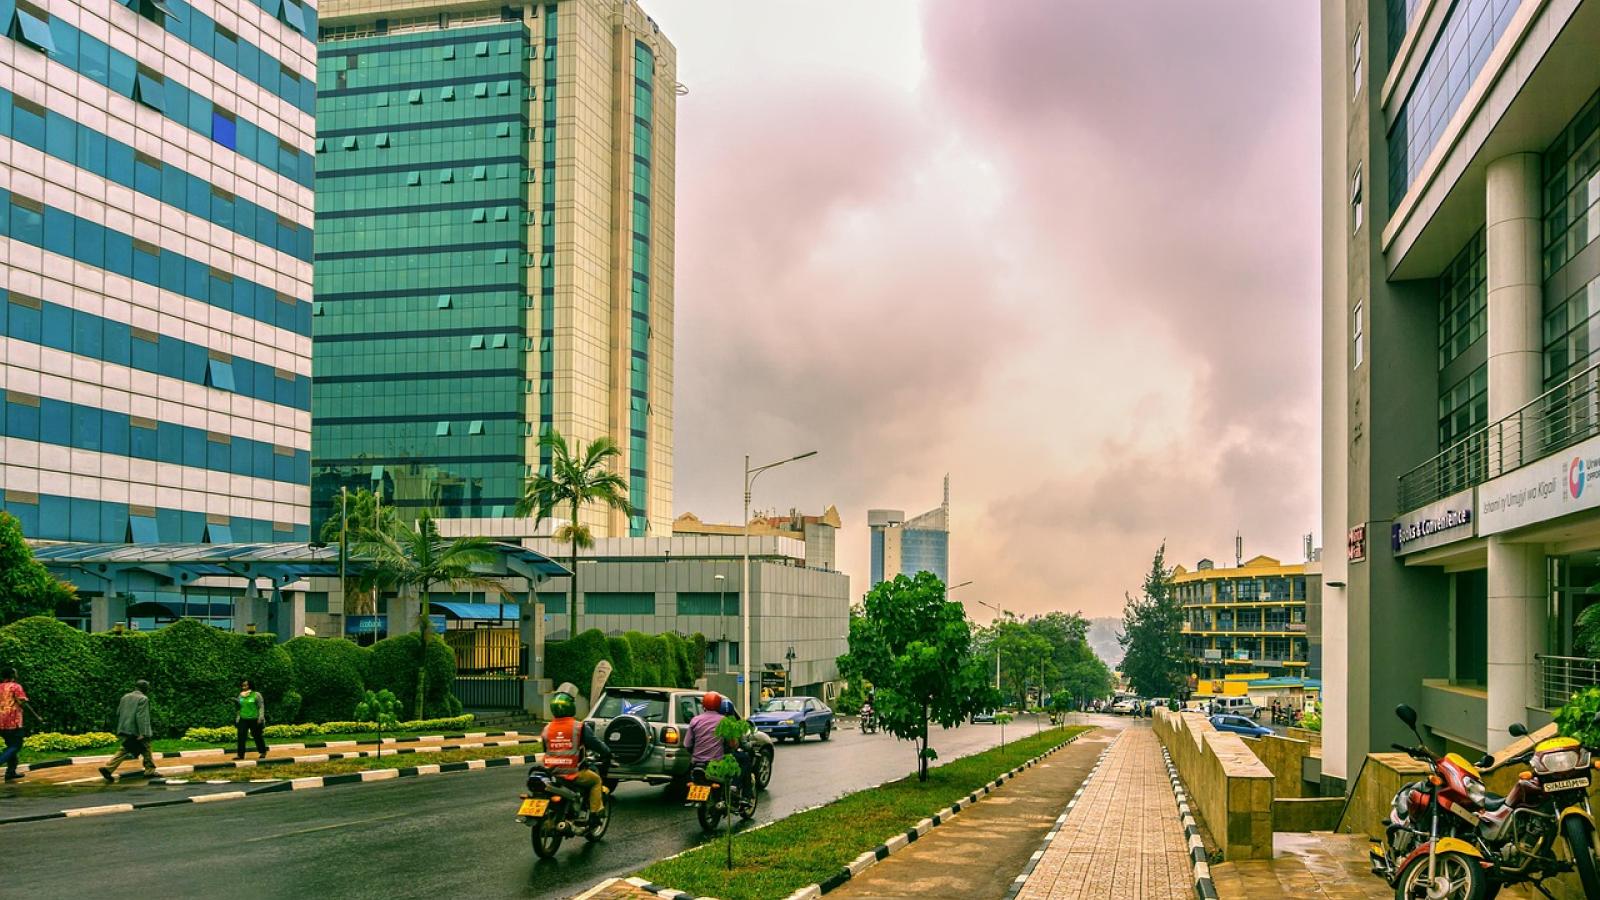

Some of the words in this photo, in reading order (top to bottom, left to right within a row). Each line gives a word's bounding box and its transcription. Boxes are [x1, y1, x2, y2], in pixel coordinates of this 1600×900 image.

[1538, 477, 1557, 499] Kigali
[1398, 525, 1415, 543] Books
[1415, 521, 1421, 538] &
[1421, 510, 1466, 536] Convenience
